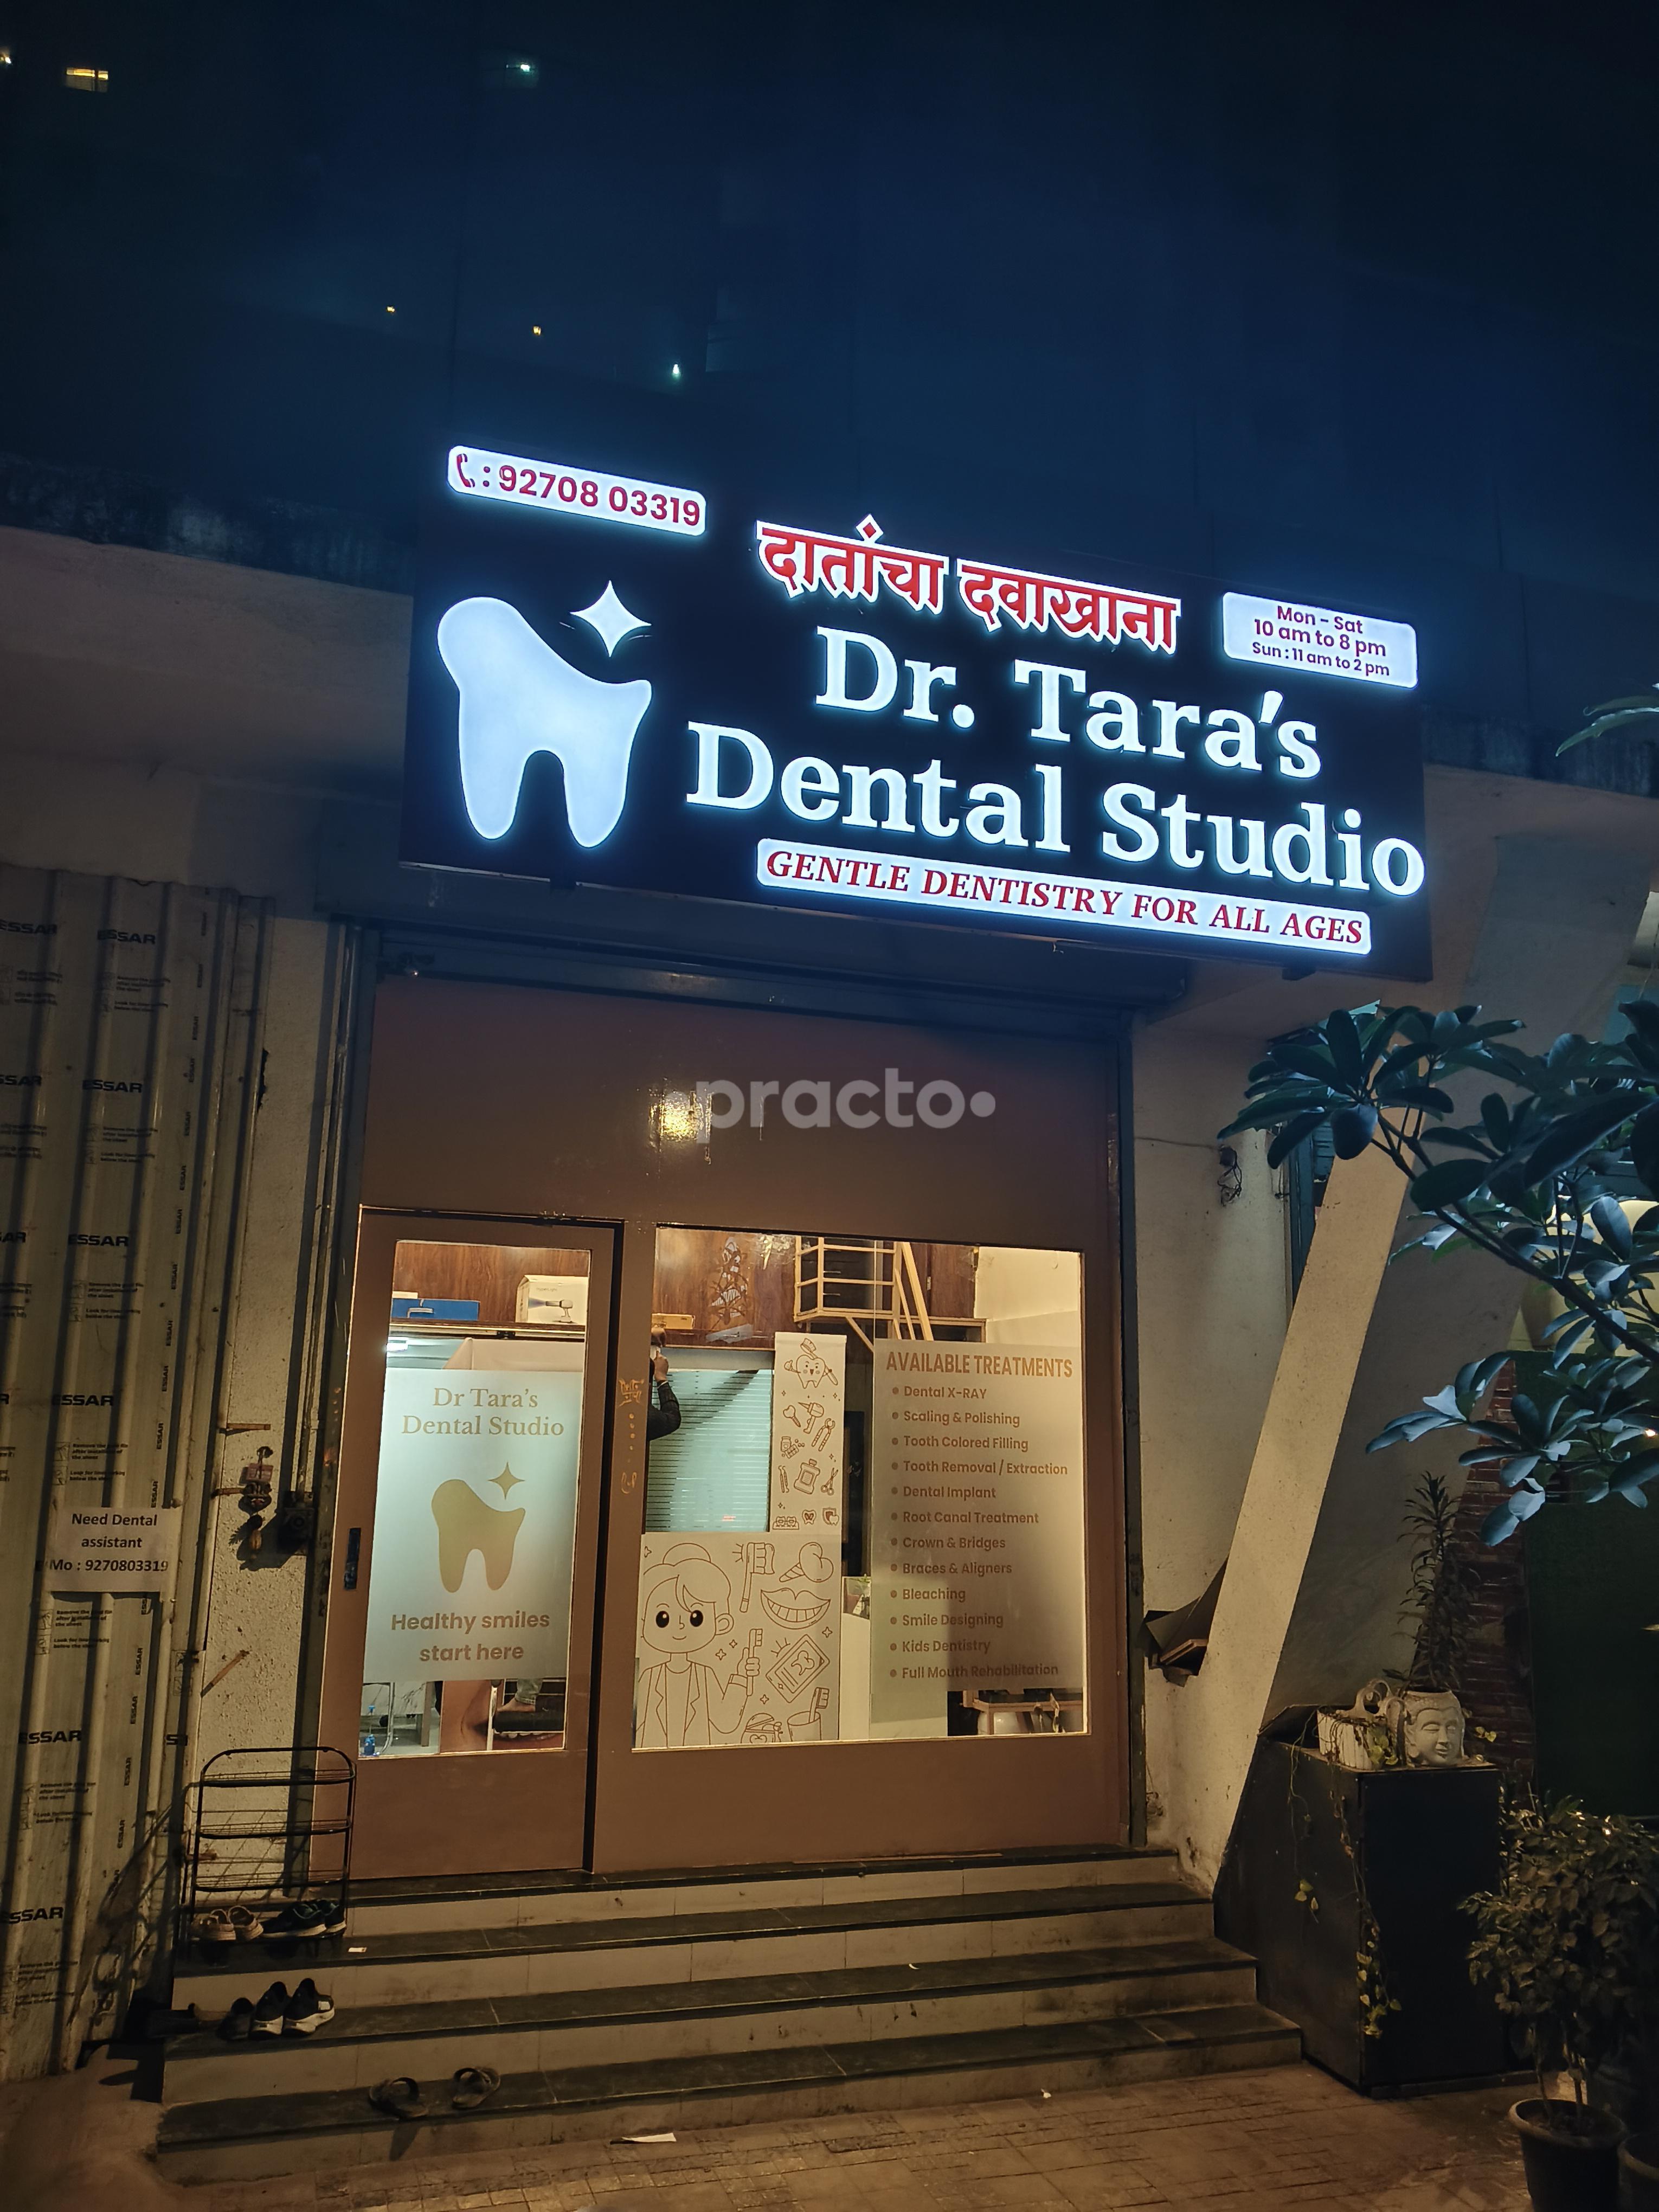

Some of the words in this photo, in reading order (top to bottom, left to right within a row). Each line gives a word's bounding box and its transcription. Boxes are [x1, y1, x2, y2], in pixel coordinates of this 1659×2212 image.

[499, 465, 599, 507] 92708
[609, 486, 700, 526] 03319
[758, 515, 948, 613] दातांचा
[957, 558, 1180, 654] दवाखाना
[1277, 606, 1315, 625] Mon
[1334, 616, 1363, 634] Sat
[1255, 619, 1274, 636] 10
[1279, 627, 1310, 643] am
[1315, 631, 1334, 647] to
[1340, 634, 1350, 650] 8
[1355, 640, 1386, 657] pm
[1252, 642, 1281, 658] Sun
[1293, 648, 1303, 661] 11
[1307, 653, 1332, 666] am
[1336, 656, 1350, 668] to
[1354, 659, 1361, 671] 2
[1366, 663, 1389, 676] pm
[816, 626, 974, 728] Dr.
[1014, 659, 1321, 779] Tara's
[686, 721, 1070, 852] Dental
[1103, 782, 1424, 896] Studio
[767, 851, 910, 892] GENTLE
[921, 870, 1123, 916] DENTISTRY
[1133, 893, 1198, 924] FOR
[1209, 904, 1270, 935] ALL
[1279, 912, 1363, 944] AGES
[97, 929, 156, 944] ESSAR
[82, 1079, 143, 1094] ESSAR
[68, 1233, 129, 1247] ESSAR
[886, 1352, 970, 1373] AVAILABLE
[974, 1355, 1072, 1378] TREATMENTS
[51, 1394, 113, 1406] ESSAR
[433, 1388, 464, 1407] Dr
[470, 1388, 538, 1408] Tara's
[904, 1386, 944, 1398] Dental
[948, 1387, 987, 1399] X-RAY
[402, 1416, 481, 1435] Dental
[488, 1417, 564, 1436] Studio
[904, 1411, 949, 1425] Scaling
[953, 1412, 961, 1423] &
[965, 1412, 1020, 1427] Polishing
[904, 1436, 938, 1447] Tooth
[942, 1437, 989, 1448] Colored
[993, 1438, 1028, 1452] Filling
[903, 1461, 938, 1472] Tooth
[942, 1461, 996, 1474] Removal
[1007, 1463, 1068, 1475] Extraction
[903, 1486, 944, 1497] Dental
[947, 1486, 996, 1501] Implant
[72, 1513, 108, 1525] Need
[112, 1514, 157, 1526] Dental
[903, 1512, 931, 1523] Root
[934, 1512, 971, 1523] Canal
[974, 1512, 1039, 1523] Treatment
[81, 1536, 142, 1548] assistant
[903, 1537, 944, 1548] Crown
[947, 1538, 956, 1548] &
[959, 1536, 1006, 1551] Bridges
[49, 1559, 73, 1571] Mo
[85, 1559, 168, 1572] 9270803319
[903, 1563, 946, 1574] Braces
[949, 1562, 958, 1574] &
[962, 1562, 1012, 1577] Aligners
[903, 1588, 966, 1603] Bleaching
[391, 1613, 476, 1634] Healthy
[481, 1610, 550, 1628] smiles
[902, 1613, 937, 1626] Smile
[941, 1613, 1004, 1629] Designing
[419, 1644, 471, 1662] start
[477, 1644, 524, 1660] here
[902, 1640, 929, 1652] Kids
[933, 1639, 991, 1654] Dentistry
[902, 1667, 924, 1679] Full
[928, 1666, 968, 1678] Mouth
[971, 1663, 1058, 1677] Rehabilitation
[18, 1729, 82, 1745] ESSAR
